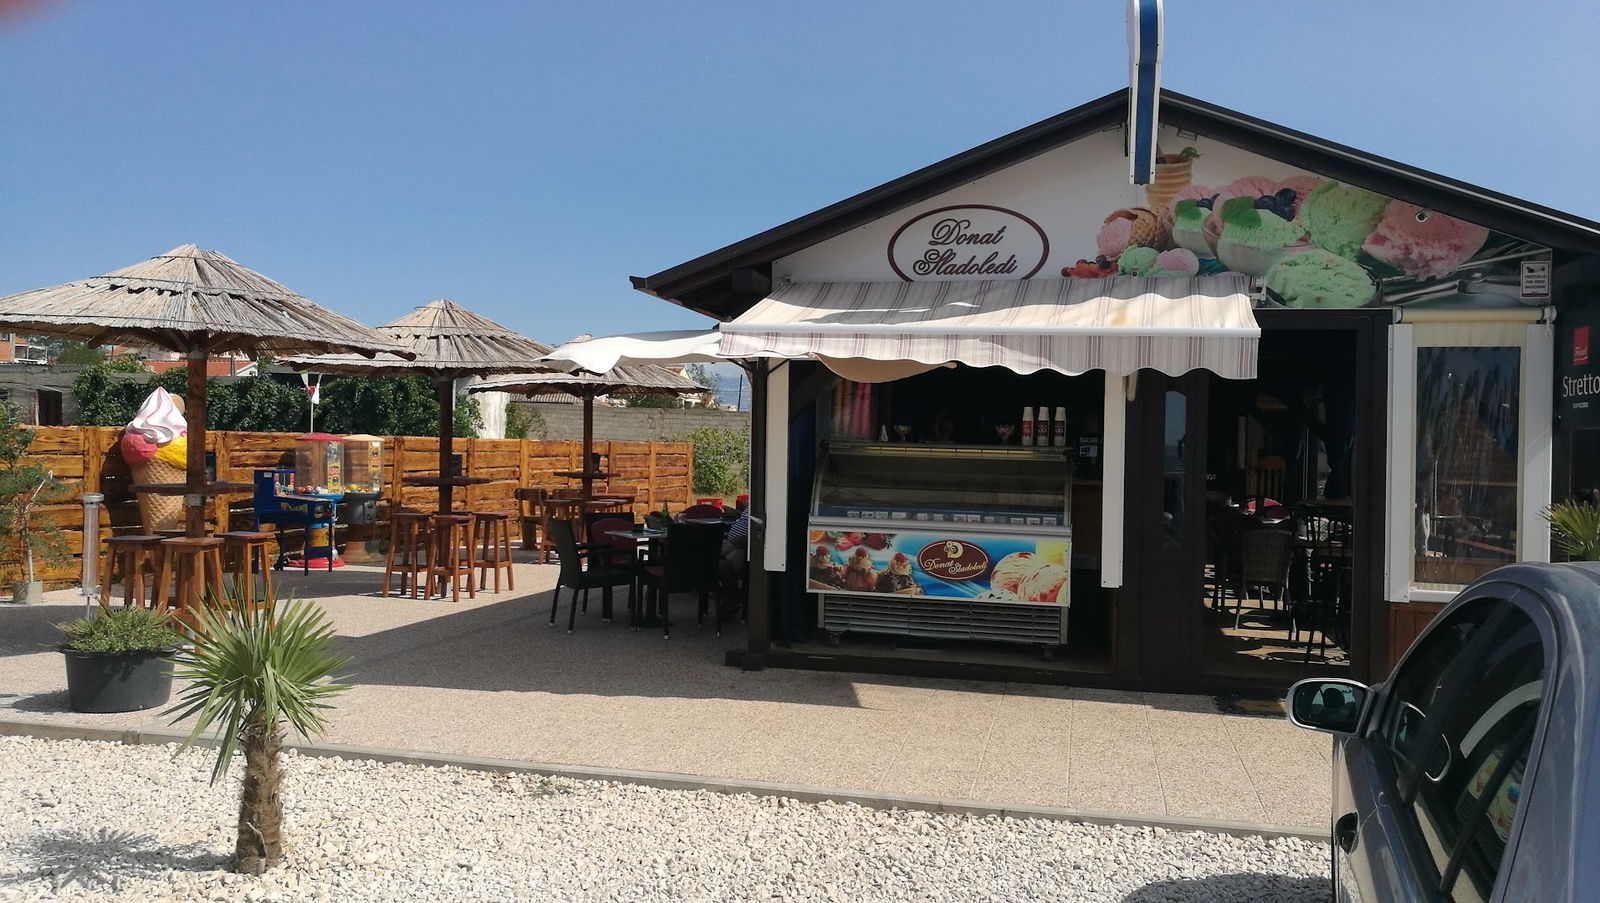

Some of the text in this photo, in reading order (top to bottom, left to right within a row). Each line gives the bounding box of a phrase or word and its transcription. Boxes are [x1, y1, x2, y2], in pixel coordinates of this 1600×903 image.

[929, 219, 1006, 245] Donat
[913, 249, 1018, 275] Sladoledi
[1562, 373, 1600, 397] Stretto
[924, 558, 988, 574] Donat Sladoledi
